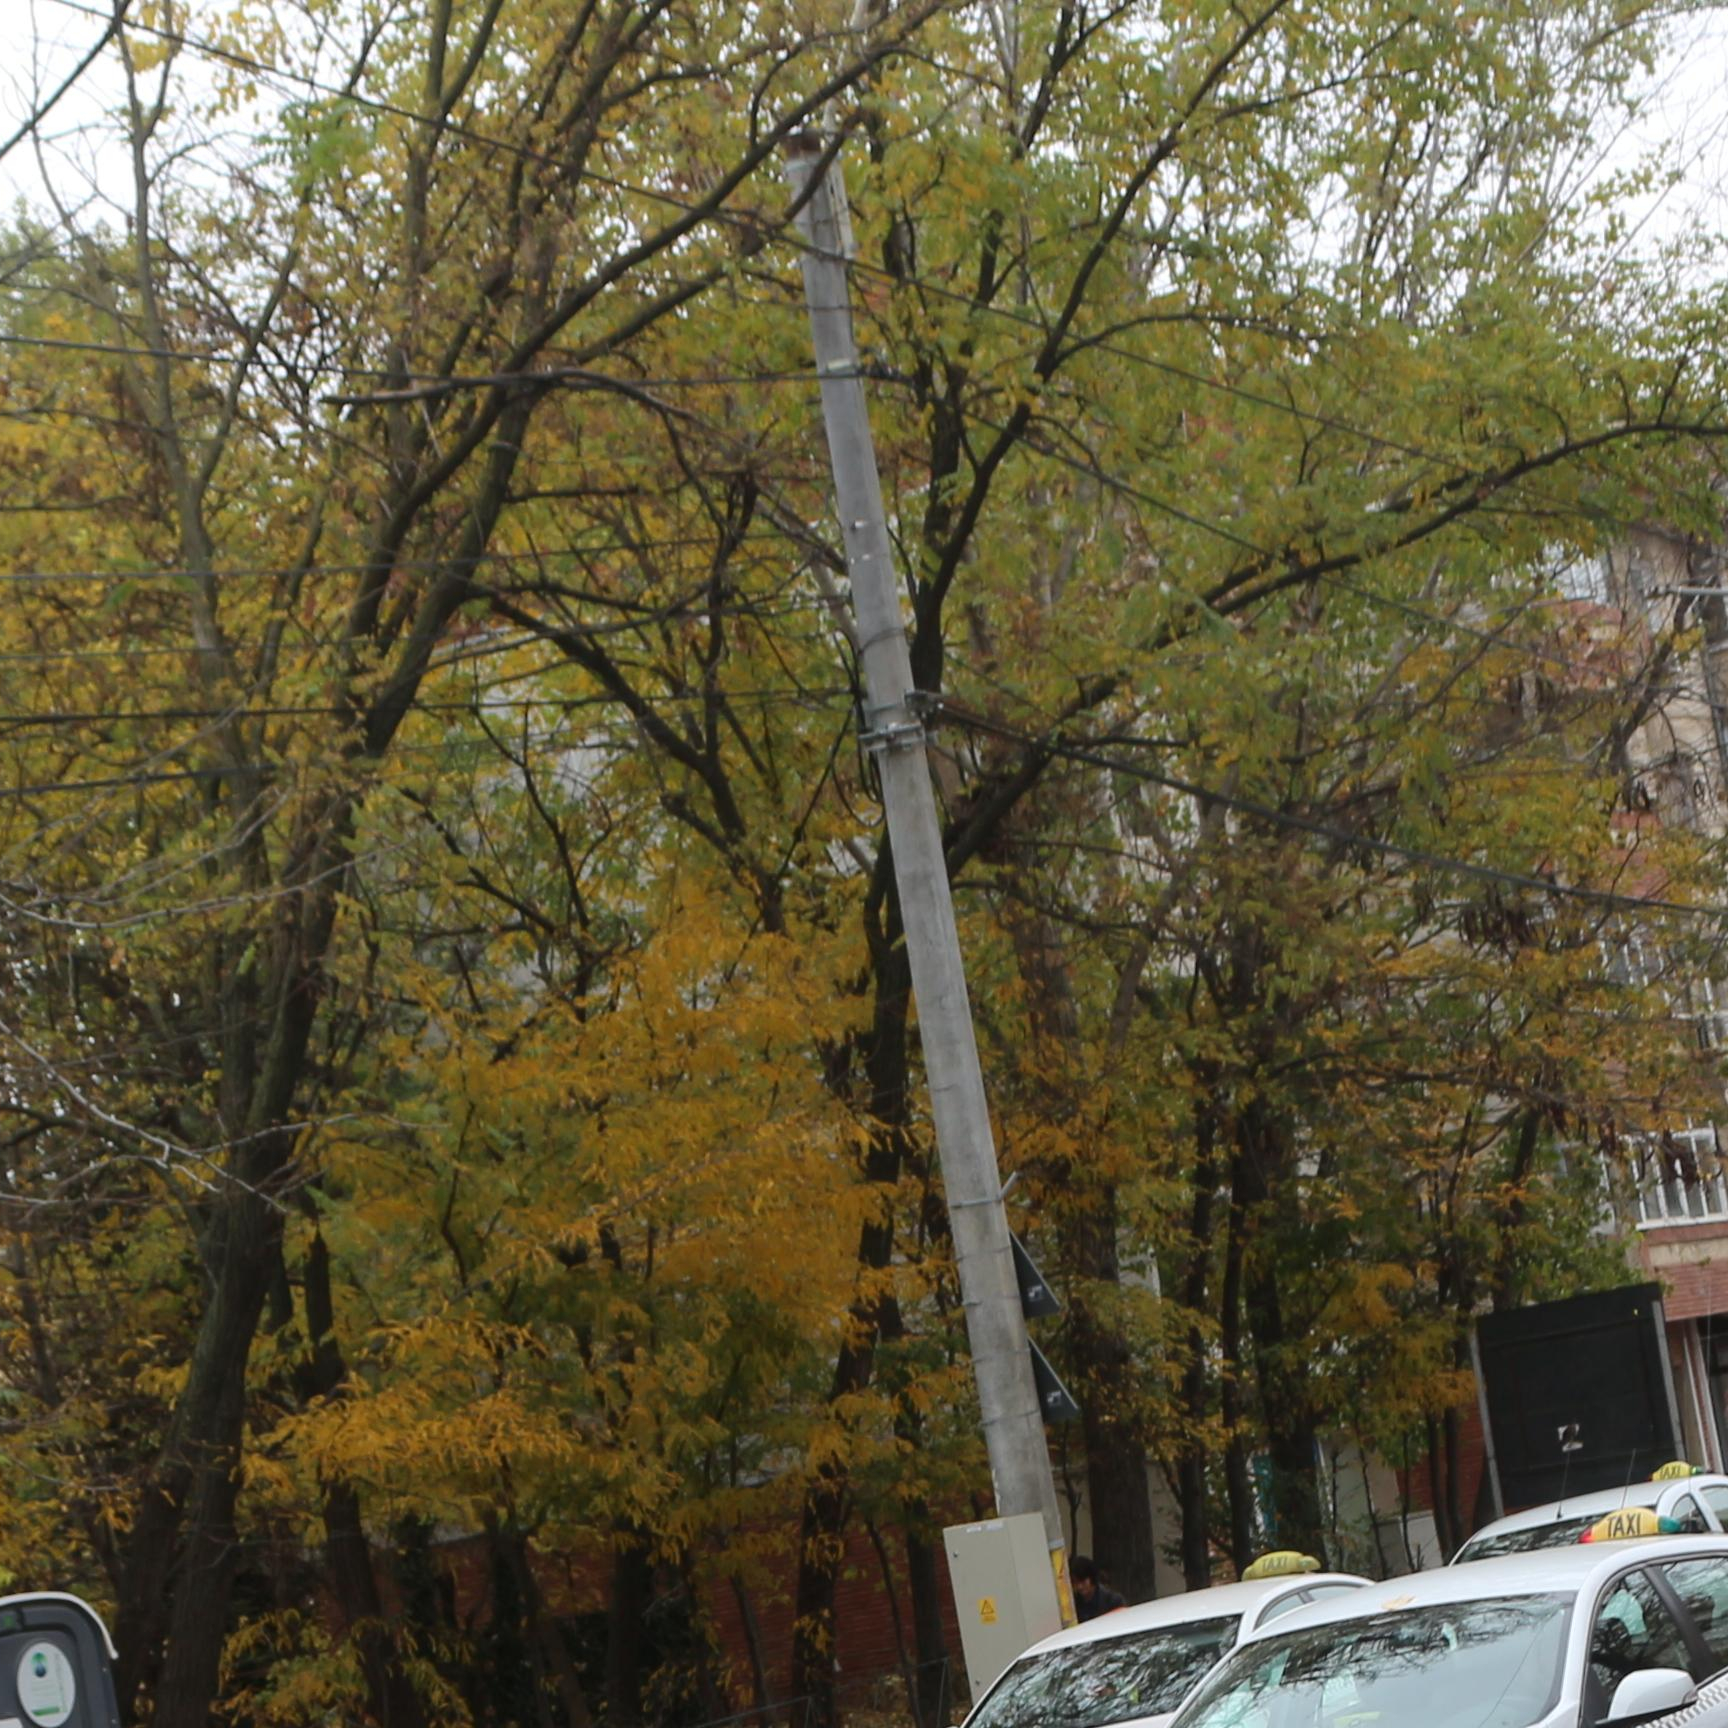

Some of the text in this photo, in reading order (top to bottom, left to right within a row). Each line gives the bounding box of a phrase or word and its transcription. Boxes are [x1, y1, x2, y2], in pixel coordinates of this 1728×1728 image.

[1659, 1465, 1681, 1480] TAXI
[1607, 1513, 1642, 1538] TAXI
[1263, 1555, 1289, 1570] TAXI
